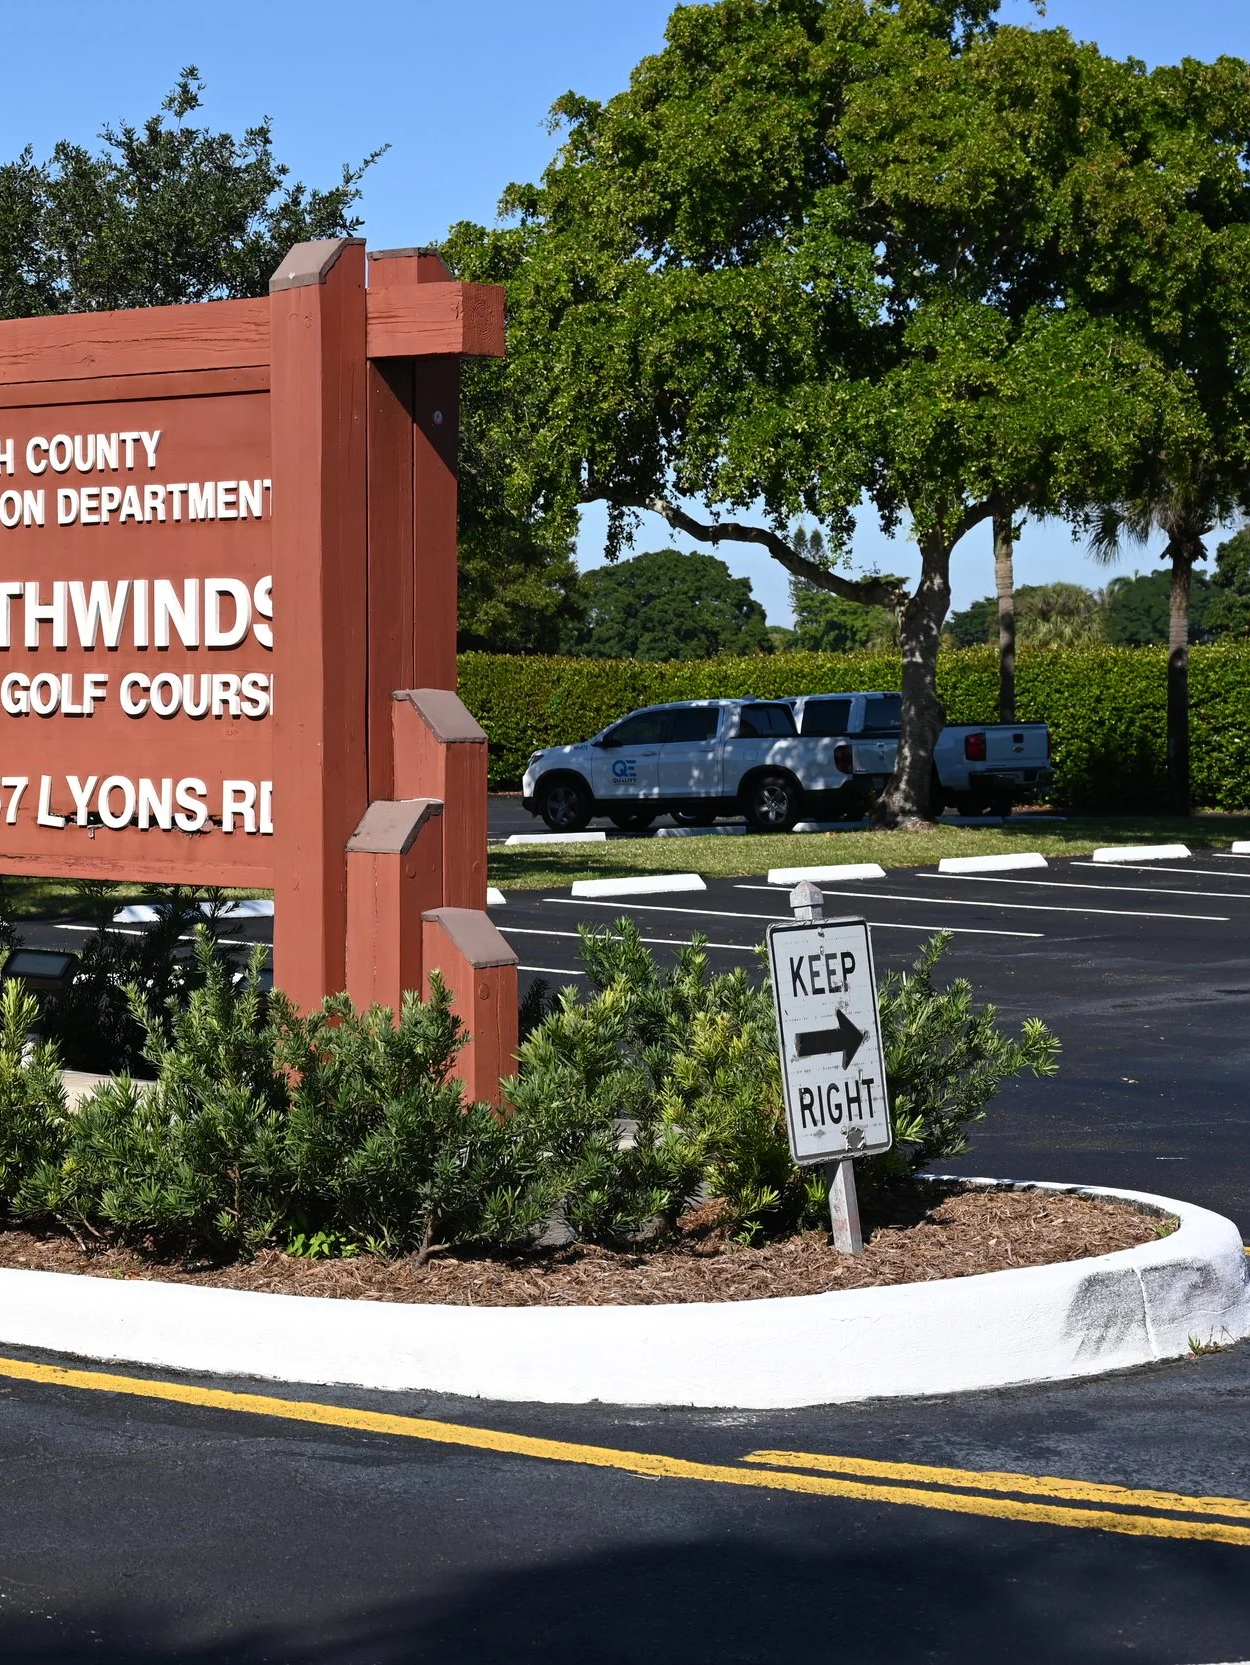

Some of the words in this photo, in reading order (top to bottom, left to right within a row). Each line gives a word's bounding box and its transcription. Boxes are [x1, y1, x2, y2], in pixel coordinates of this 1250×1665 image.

[26, 430, 160, 473] COUNTY
[1, 672, 108, 714] GOLF
[120, 673, 273, 716] COURS
[37, 775, 208, 831] LYONS
[789, 951, 855, 997] KEEP
[798, 1078, 874, 1128] RIGHT
